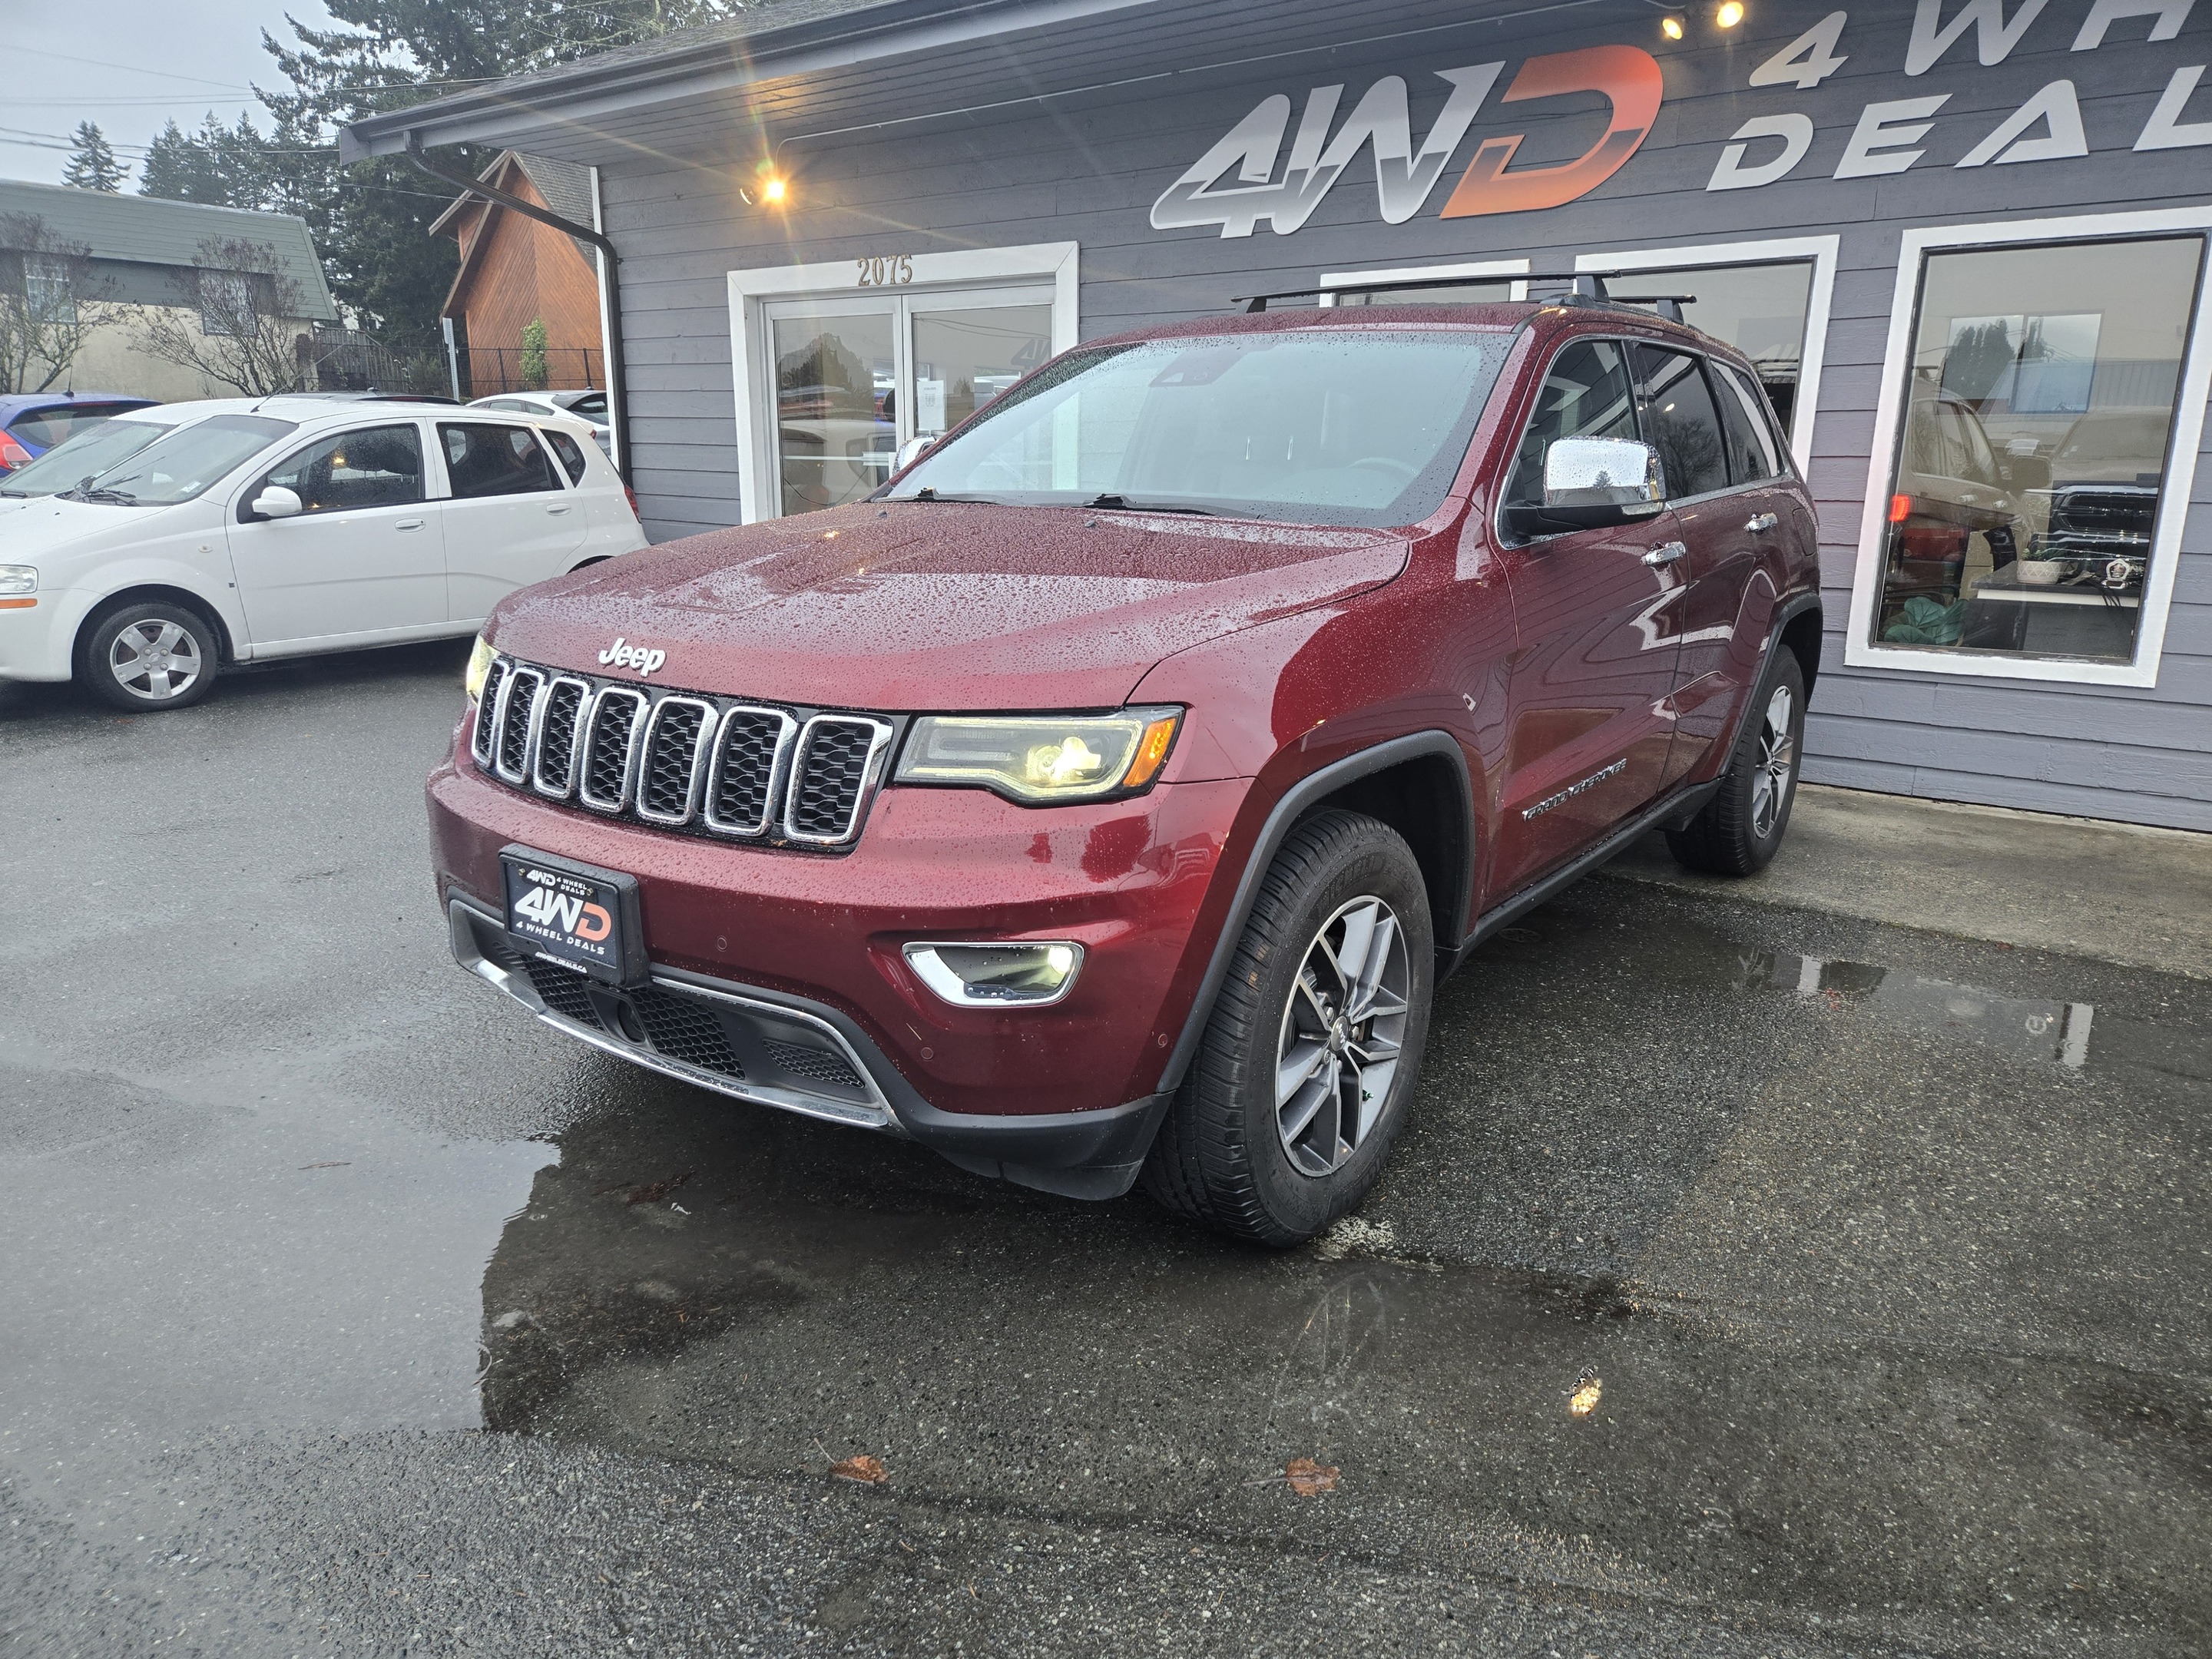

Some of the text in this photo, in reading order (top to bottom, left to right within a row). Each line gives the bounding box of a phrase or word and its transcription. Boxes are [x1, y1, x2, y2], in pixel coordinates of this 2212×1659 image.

[1749, 10, 1849, 89] 4
[1150, 45, 1664, 239] 4WD
[1705, 65, 2212, 191] DEAL
[857, 253, 912, 286] 2075
[599, 637, 666, 677] Jeep
[526, 869, 556, 886] 4WD
[560, 884, 585, 896] DEALS
[562, 878, 587, 890] WHEEL
[515, 886, 611, 942] 4WD
[526, 924, 562, 941] WHEEL
[566, 936, 605, 955] DEALS
